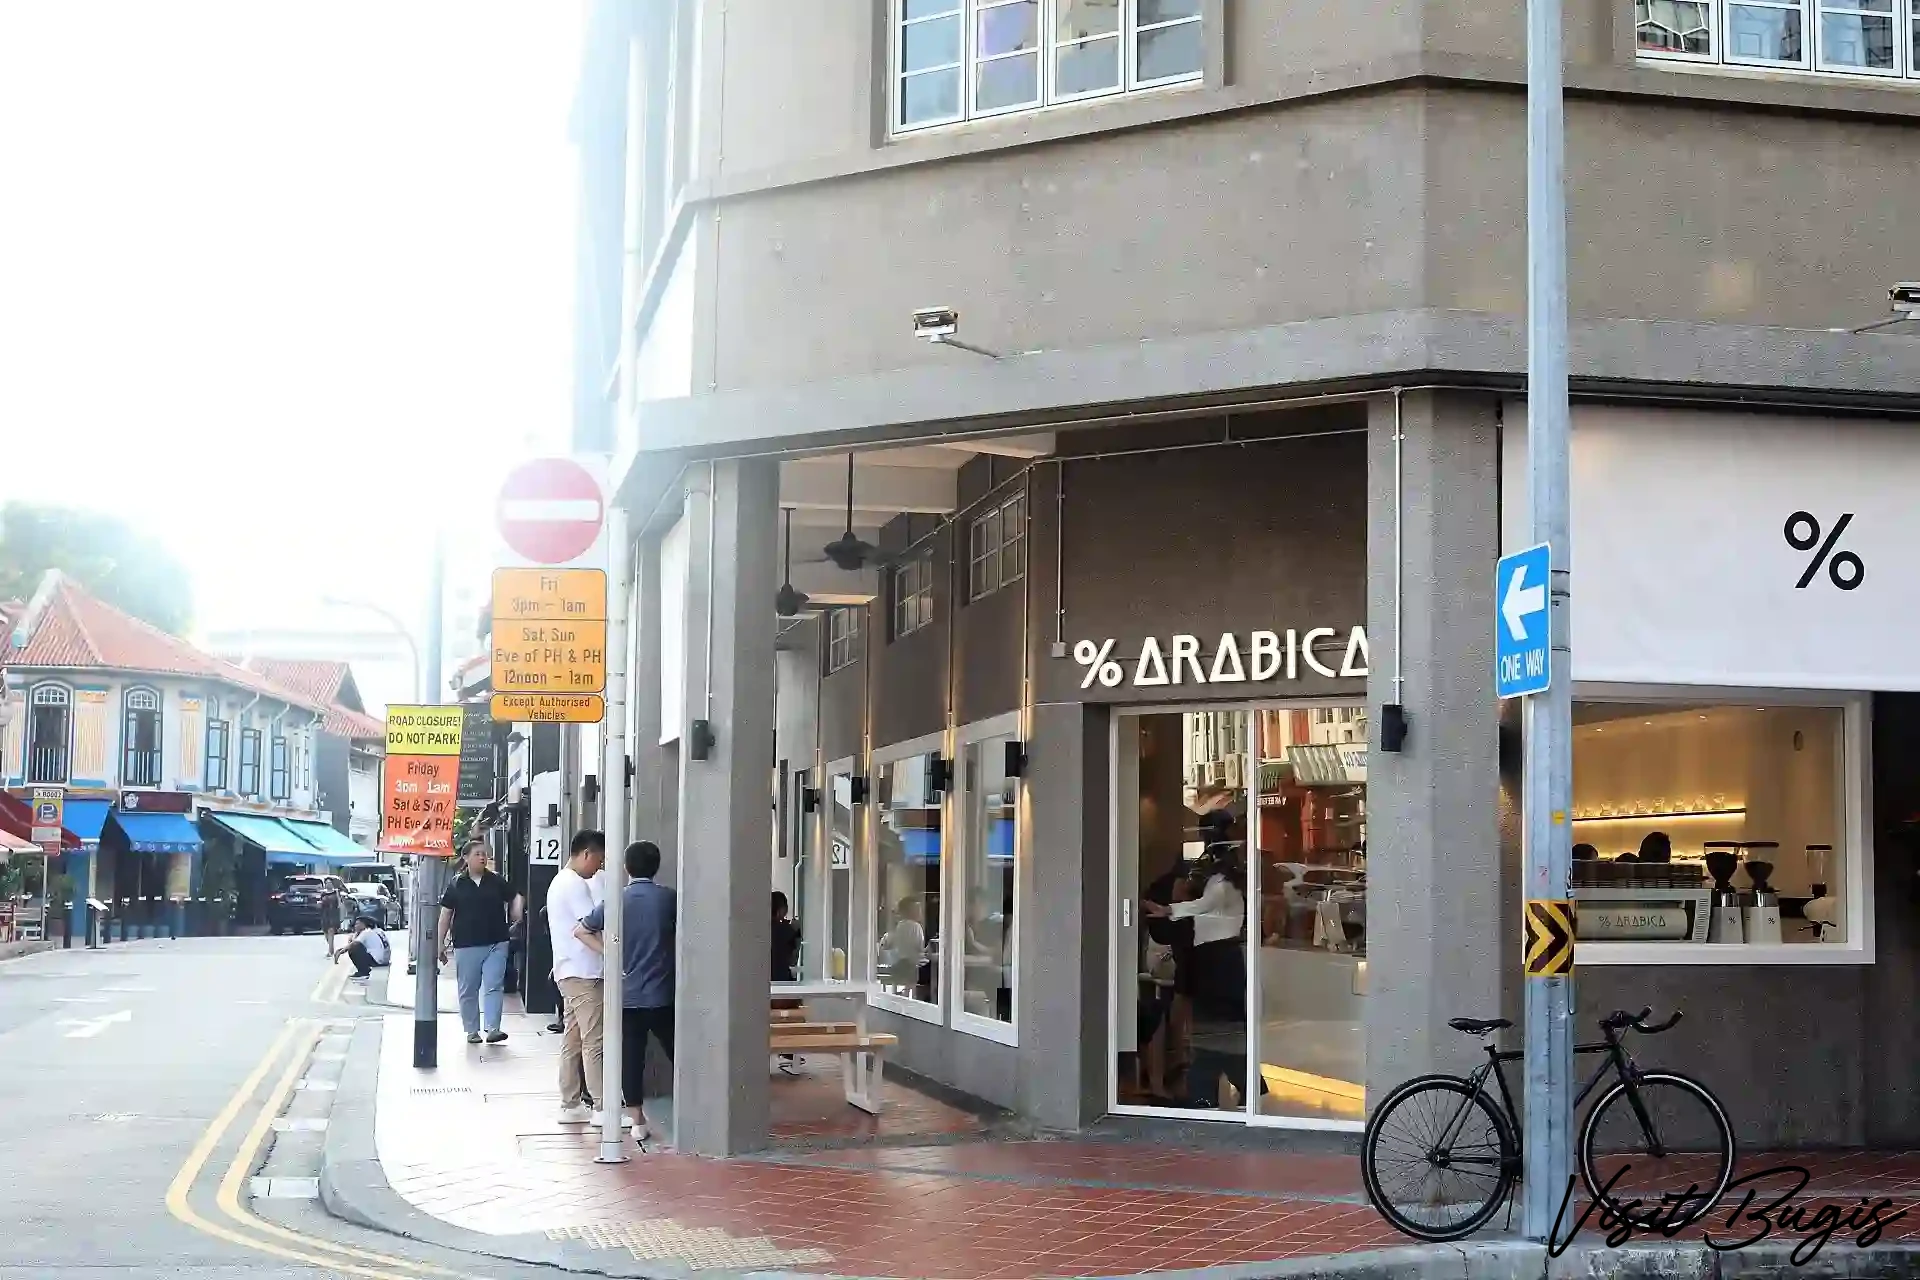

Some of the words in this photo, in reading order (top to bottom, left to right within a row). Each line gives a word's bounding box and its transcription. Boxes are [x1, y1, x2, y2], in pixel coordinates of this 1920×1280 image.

[1783, 510, 1865, 591] %
[540, 576, 558, 592] Fri
[511, 598, 539, 615] 3pm
[560, 597, 586, 613] 1am
[522, 627, 548, 642] Sat,
[551, 628, 575, 642] Sun
[494, 648, 520, 662] Eve
[524, 648, 538, 663] of
[544, 648, 562, 663] PH
[568, 649, 577, 663] &
[583, 649, 601, 664] PH
[1133, 625, 1368, 686] ARABICA
[1500, 653, 1521, 683] ONE
[1525, 648, 1545, 678] WAY
[503, 670, 547, 684] 12noon
[568, 670, 594, 685] 1am
[503, 695, 535, 708] Except
[539, 696, 590, 708] Authorised
[388, 715, 415, 726] ROAD
[416, 716, 461, 727] CLOSURE!
[528, 709, 566, 721] Vehicles
[388, 732, 403, 744] DO
[406, 732, 425, 745] NOT
[427, 732, 461, 745] PARK!
[407, 761, 440, 778] Friday
[387, 815, 402, 829] PH
[535, 838, 560, 860] 12
